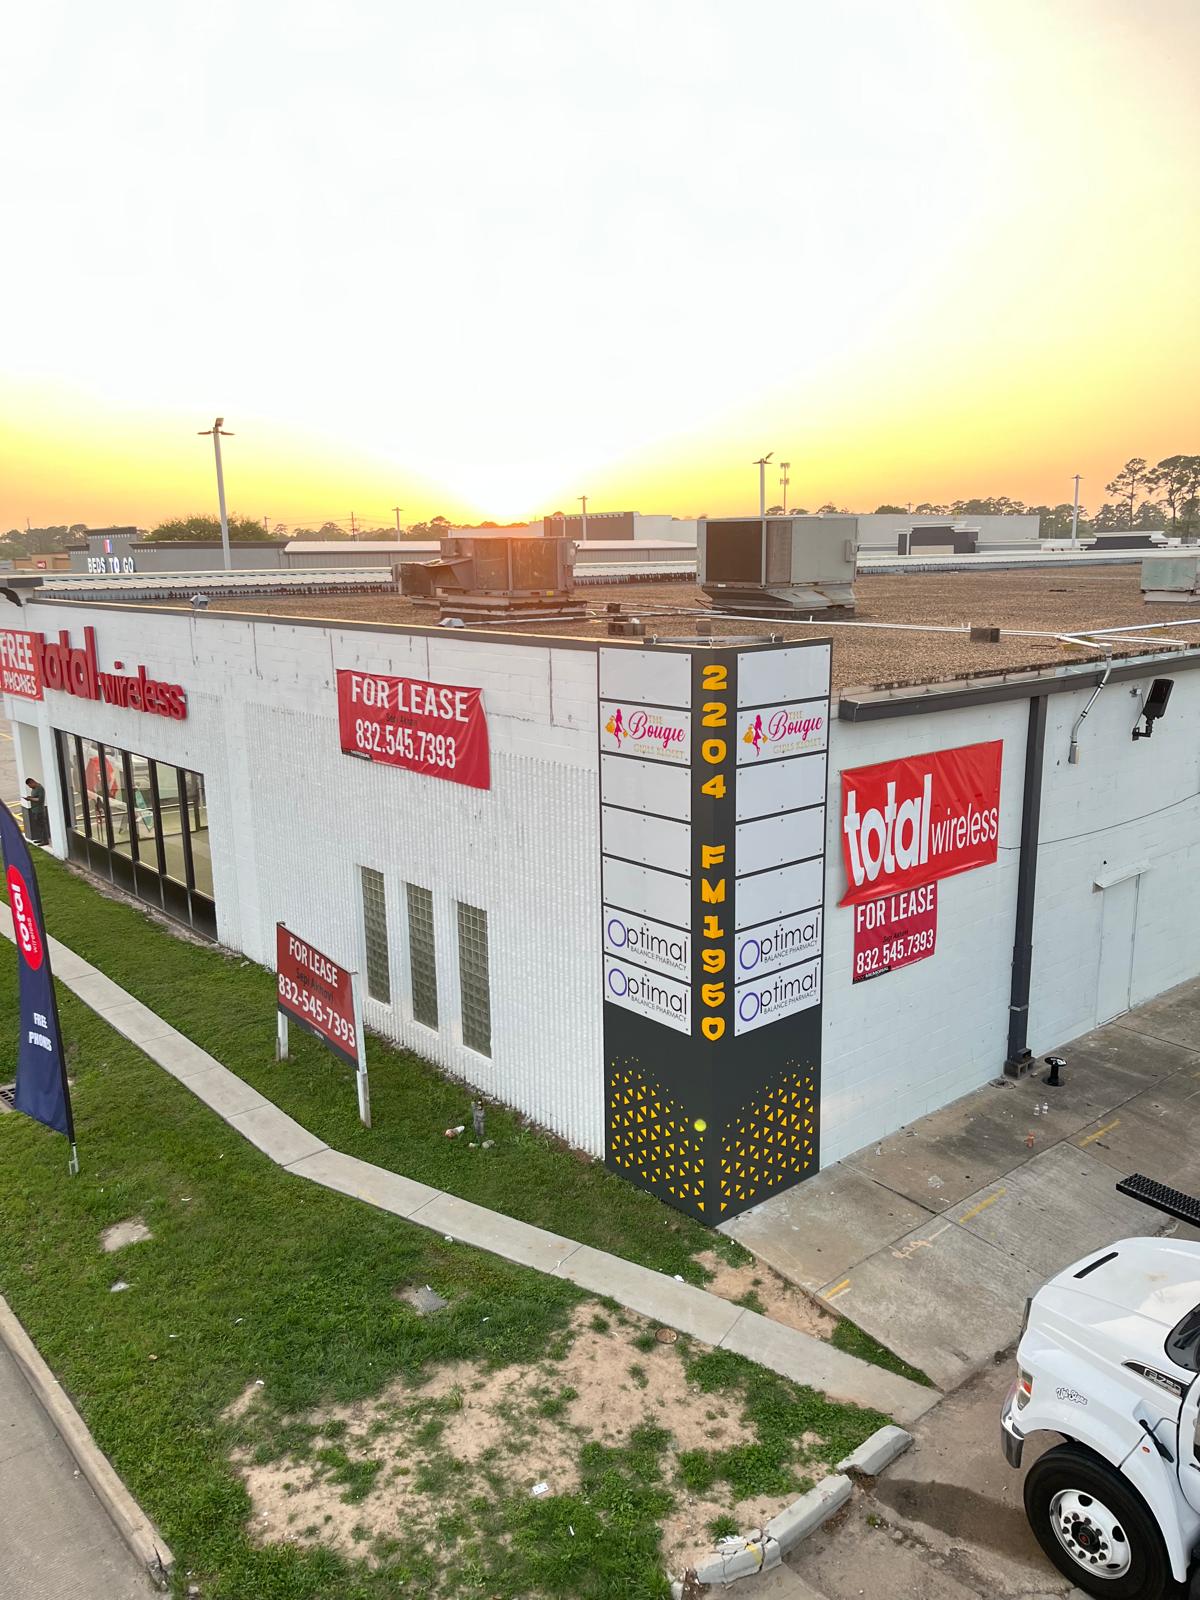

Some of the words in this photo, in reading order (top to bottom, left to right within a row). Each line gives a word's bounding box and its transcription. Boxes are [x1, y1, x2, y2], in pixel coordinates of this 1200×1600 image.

[88, 557, 106, 573] BEDS
[109, 557, 120, 574] TO
[123, 556, 134, 573] GO
[0, 632, 35, 672] FREE
[37, 626, 101, 700] total
[99, 661, 189, 720] wireless
[3, 670, 37, 695] PHONES
[351, 675, 389, 709] FOR
[398, 682, 469, 723] LEASE
[355, 718, 456, 769] 832.545.7393
[628, 710, 686, 749] Bougie
[768, 709, 823, 741] Bougie
[844, 773, 932, 887] total
[931, 803, 998, 856] wireless
[11, 883, 32, 952] total
[856, 899, 886, 933] FOR
[890, 884, 935, 924] LEASE
[289, 936, 307, 967] FOR
[309, 949, 338, 989] LEASE
[608, 919, 687, 964] Optimal
[630, 946, 655, 960] BALANCE
[655, 955, 687, 971] PHARMACY
[740, 917, 818, 970] Optimal
[764, 950, 790, 964] BALANCE
[789, 941, 818, 956] PHARMACY
[856, 928, 935, 974] 832.545.7393
[278, 973, 356, 1048] 832-545-7393
[608, 968, 687, 1015] Optimal
[631, 995, 655, 1010] BALANCE
[655, 1005, 687, 1022] PHARMACY
[739, 967, 817, 1022] Optimal
[763, 1000, 788, 1014] BALANCE
[788, 991, 817, 1006] PHARMACY
[33, 1012, 48, 1029] FREE
